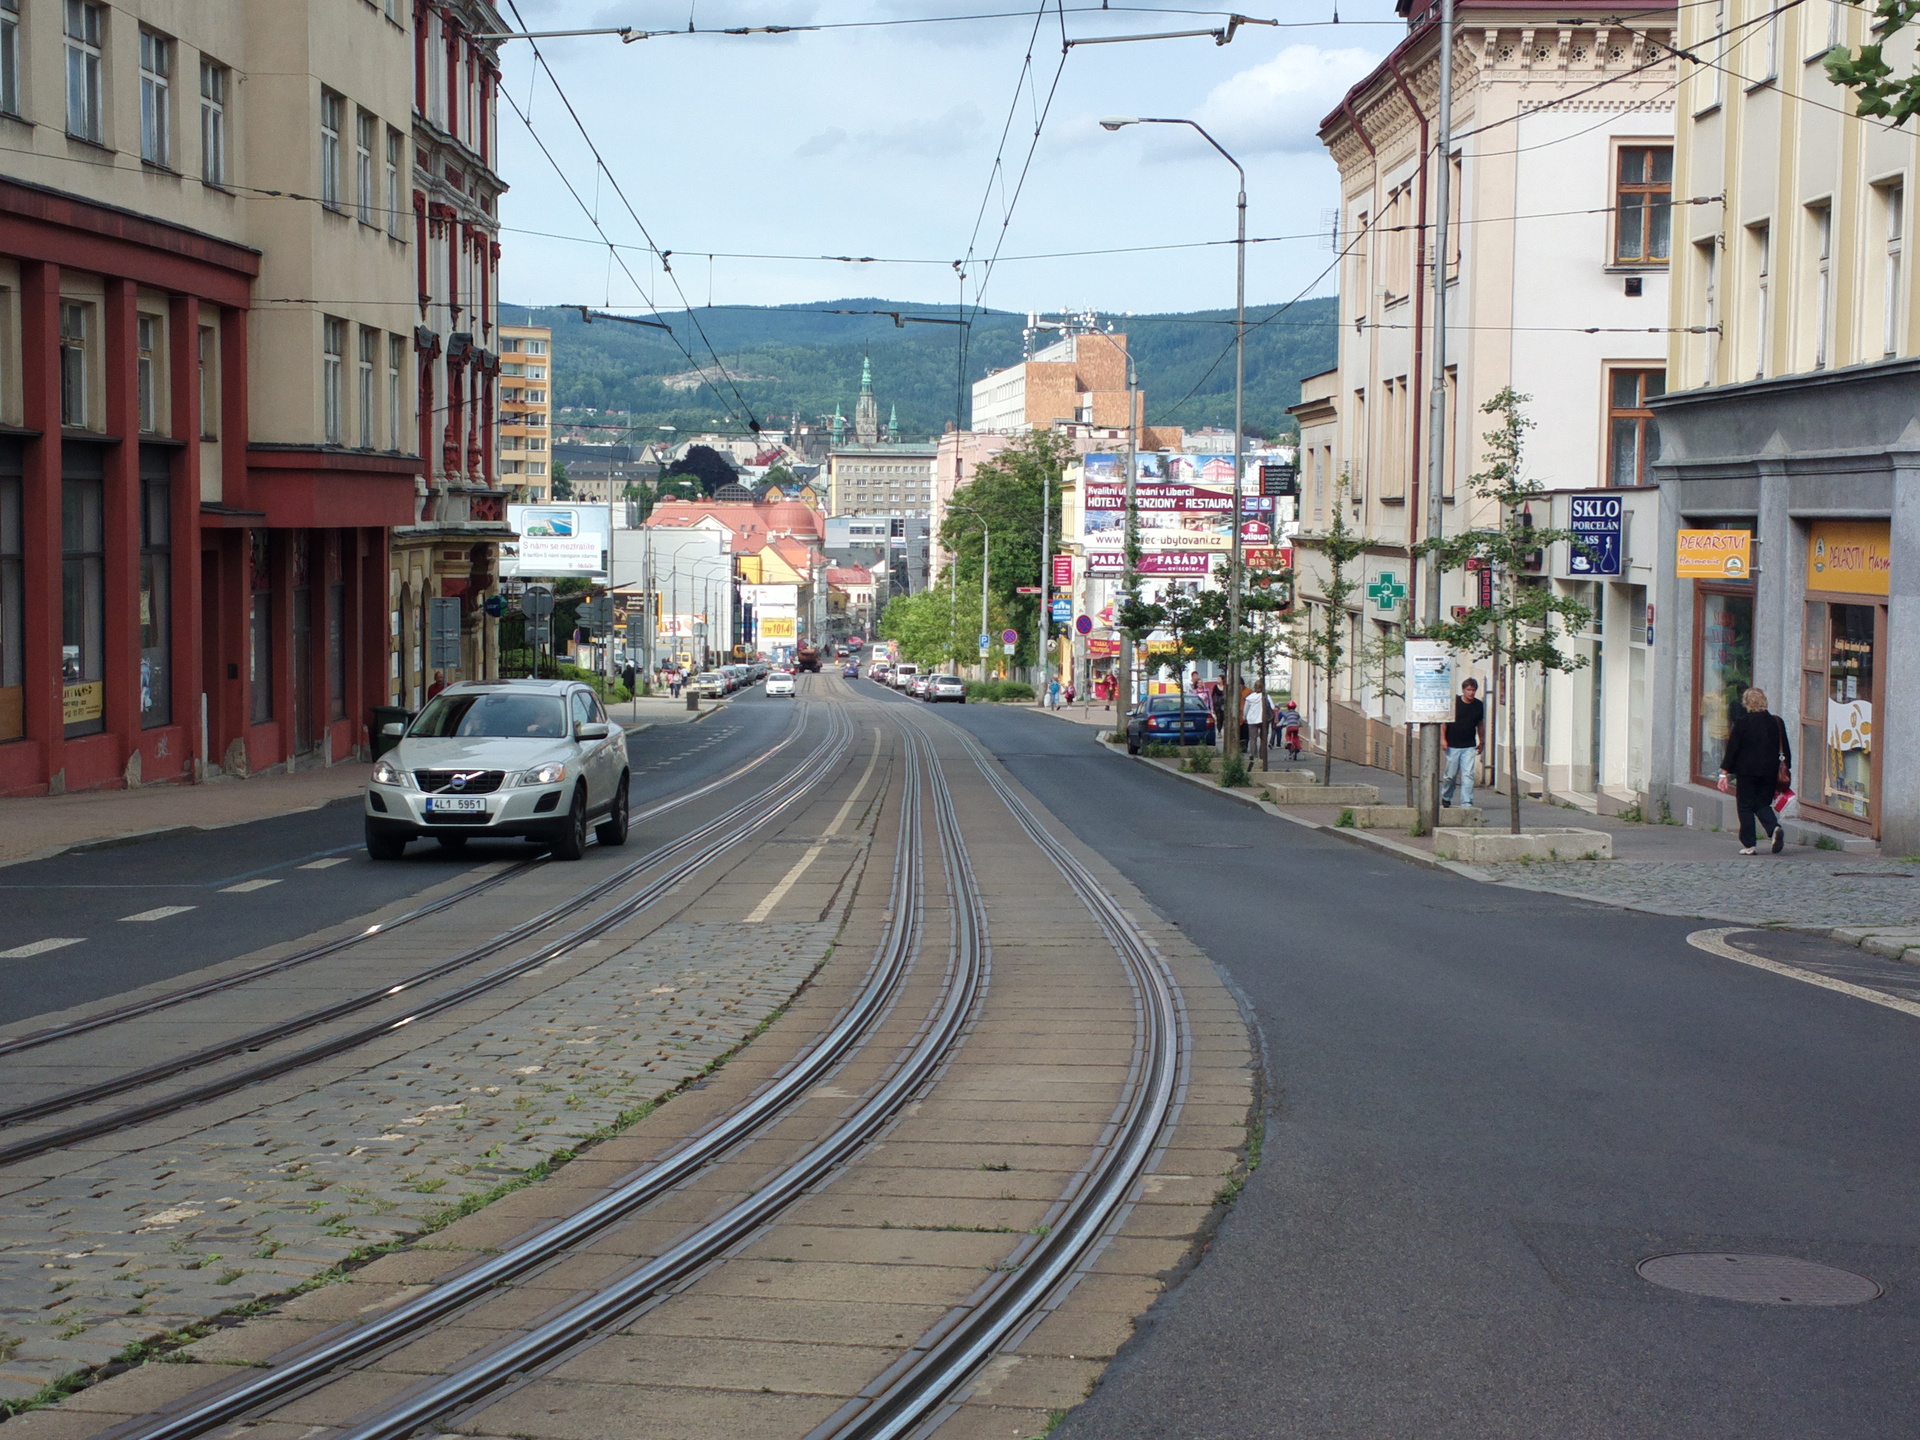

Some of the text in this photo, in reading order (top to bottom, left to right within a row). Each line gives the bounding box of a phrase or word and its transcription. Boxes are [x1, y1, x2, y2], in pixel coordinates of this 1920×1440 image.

[1088, 486, 1117, 495] Kvalitní
[1119, 487, 1158, 496] ubování
[1166, 487, 1194, 496] Liberci!
[1088, 497, 1122, 507] HOTELY
[1573, 500, 1619, 517] SKLO
[1573, 519, 1619, 530] PORCELÁN
[1578, 535, 1599, 545] LASS
[1680, 532, 1748, 550] PEKAŘSTVÍ
[523, 541, 529, 550] S
[530, 542, 548, 550] námi
[1157, 553, 1206, 564] FASÁDY
[1253, 550, 1283, 558] ASIA
[1829, 541, 1866, 570] PEKAŘSTVÍ
[1249, 558, 1287, 566] BISO
[773, 624, 791, 634] 101.4
[434, 800, 480, 809] 4L1 5951
